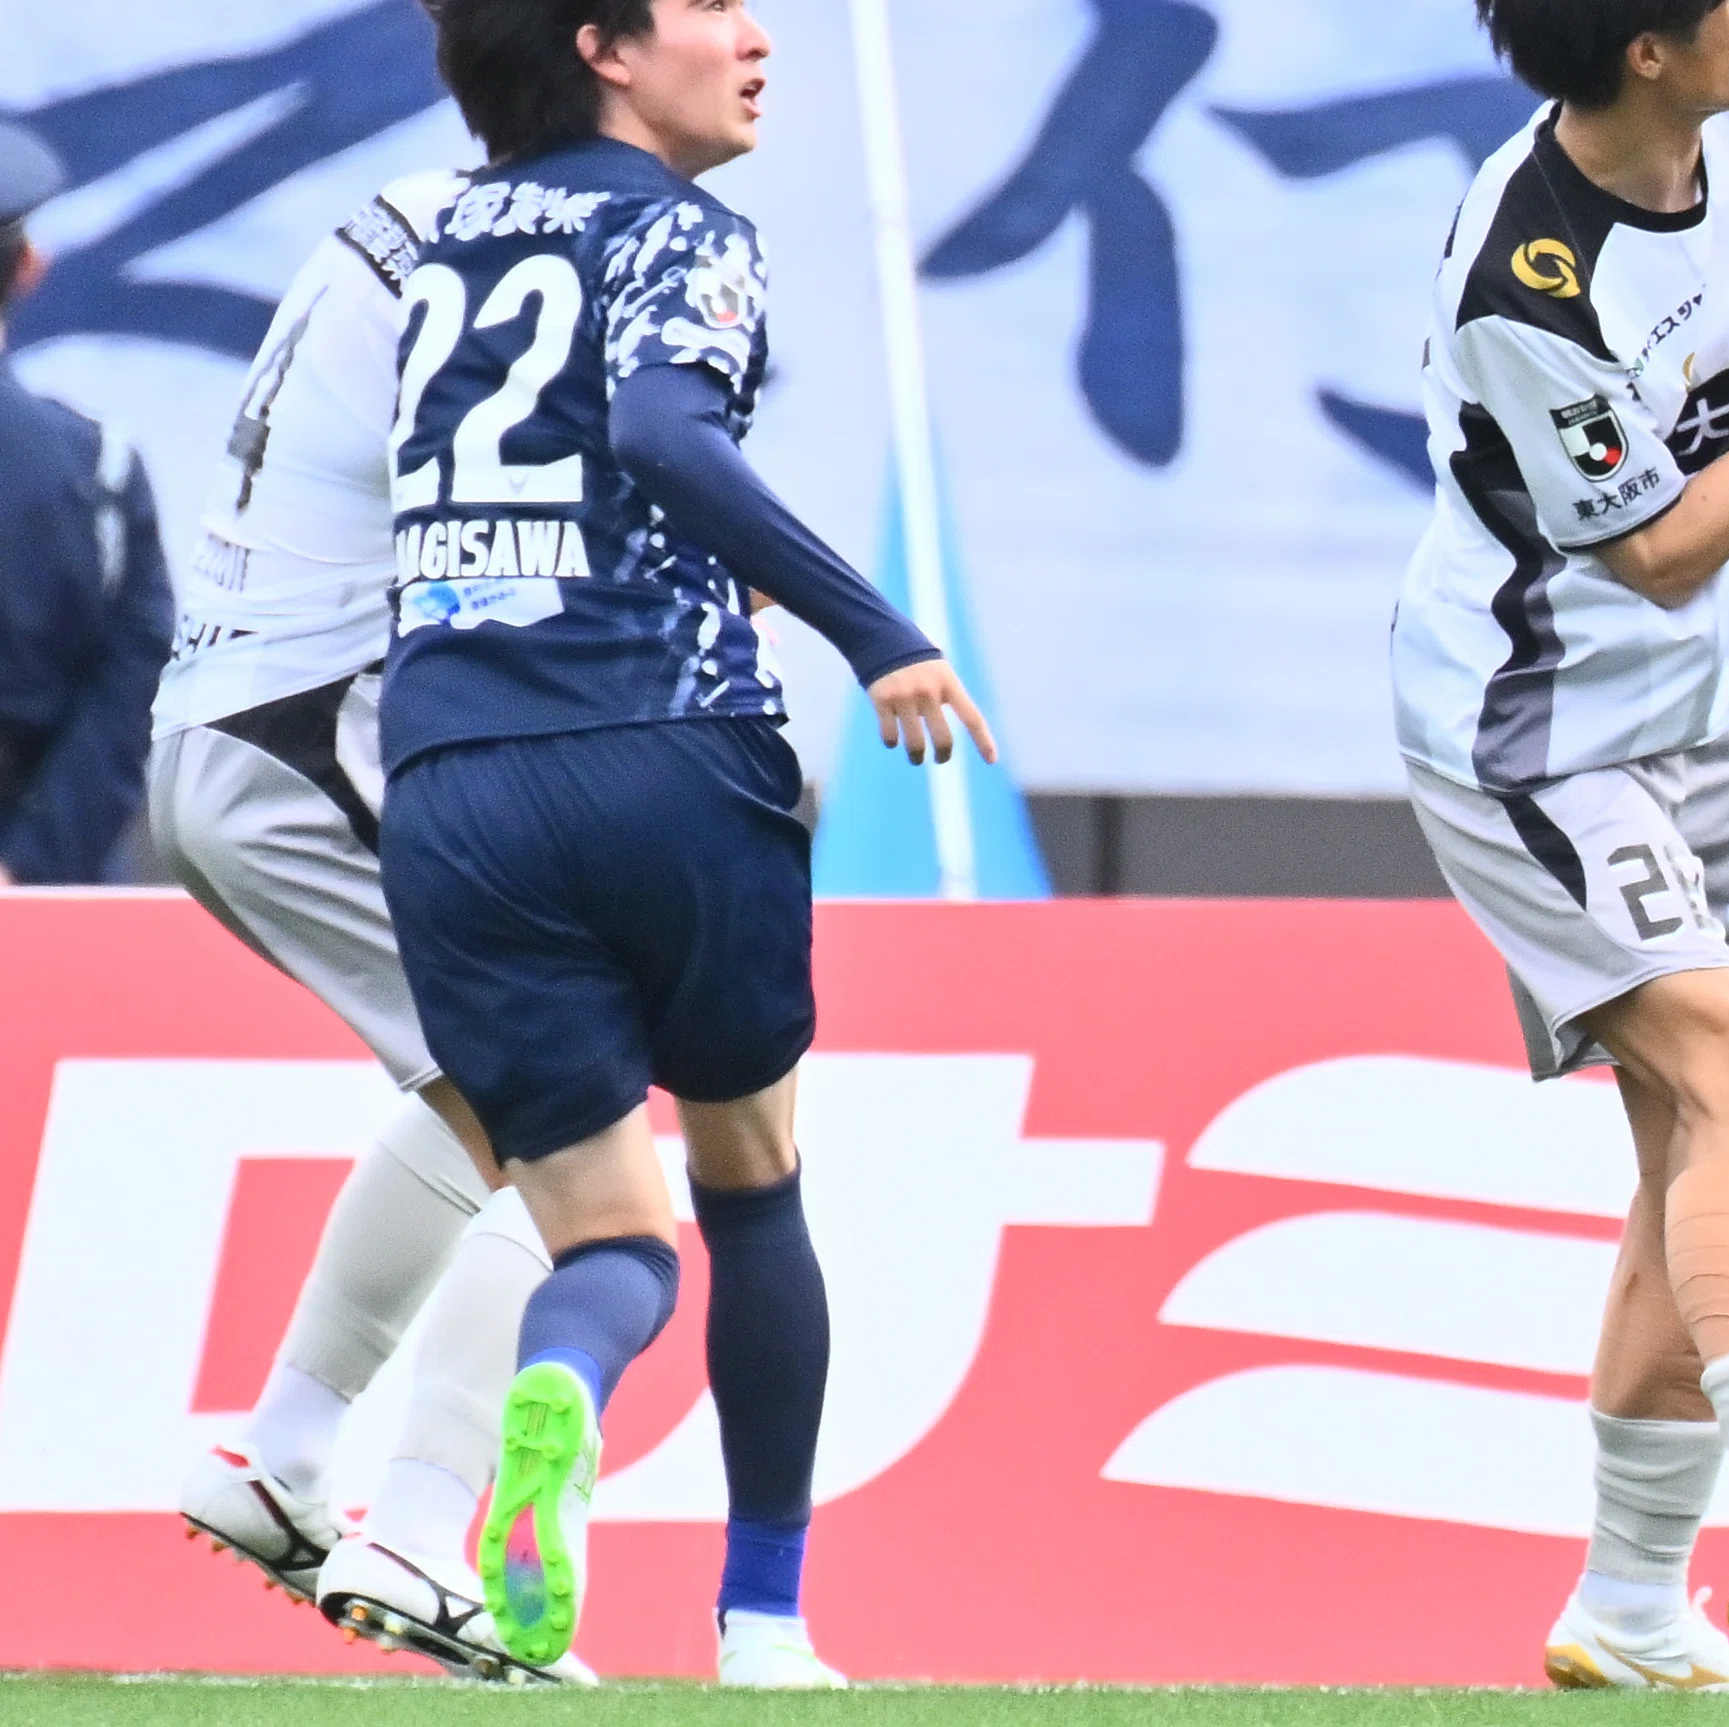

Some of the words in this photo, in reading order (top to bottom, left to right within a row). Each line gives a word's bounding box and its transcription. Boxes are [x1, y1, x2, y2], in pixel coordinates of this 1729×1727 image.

[391, 253, 584, 514] 22
[1572, 467, 1661, 521] 東大阪市
